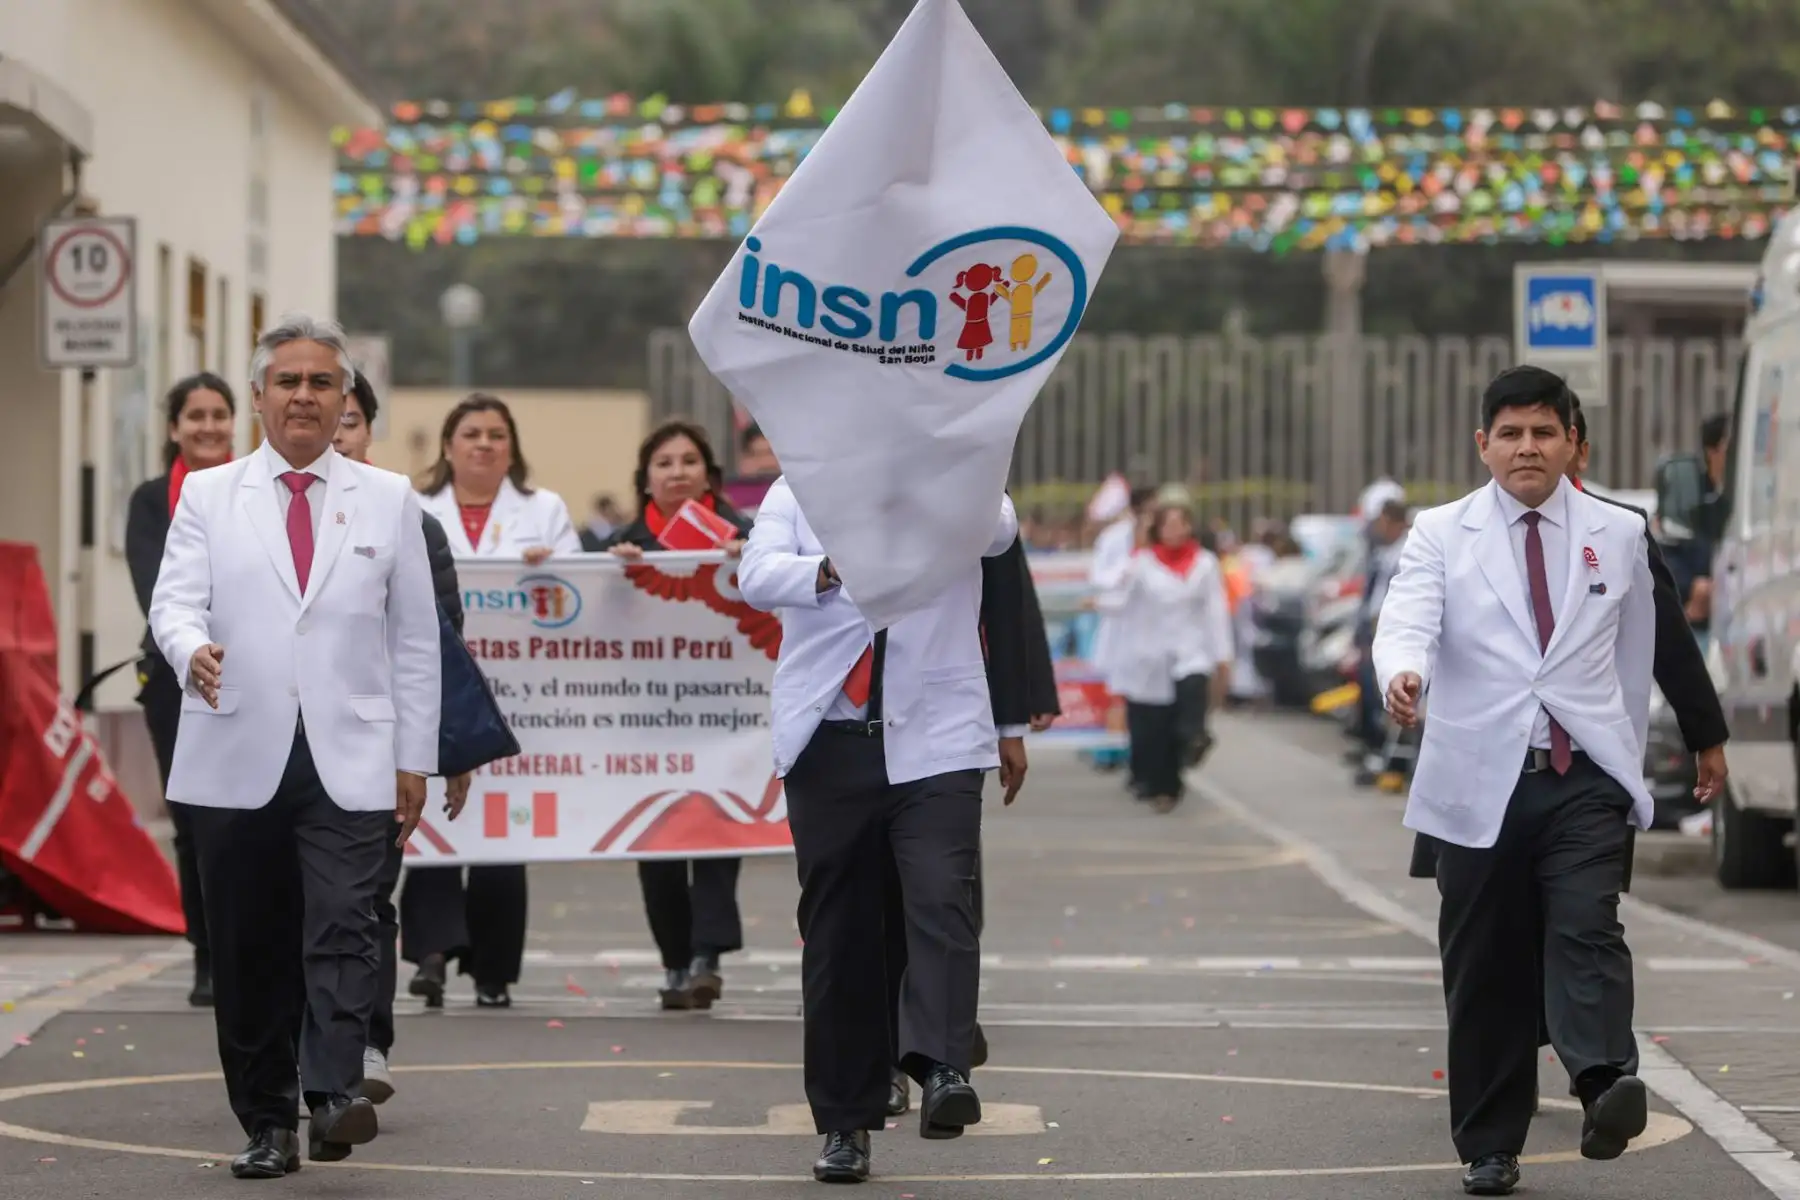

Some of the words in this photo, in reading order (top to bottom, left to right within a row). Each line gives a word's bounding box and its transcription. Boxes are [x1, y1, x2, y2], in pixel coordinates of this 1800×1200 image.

[71, 244, 108, 273] 10
[739, 236, 937, 342] insn
[738, 312, 782, 333] Instituto
[783, 326, 832, 348] Nacional
[834, 340, 849, 351] de
[851, 343, 885, 355] Salud
[888, 345, 906, 354] del
[908, 343, 935, 353] Niño
[879, 355, 902, 364] San
[904, 354, 935, 364] Borja
[463, 590, 528, 610] nsn
[466, 637, 520, 660] stas
[529, 636, 623, 660] Patrias
[632, 636, 664, 660] mi
[673, 634, 733, 660] Perú
[541, 677, 558, 697] el
[565, 677, 641, 697] mundo
[647, 680, 668, 697] tu
[674, 677, 770, 702] pasarela,
[593, 713, 613, 728] es
[620, 708, 693, 728] mucho
[699, 708, 769, 732] mejor.
[490, 753, 583, 776] GENERAL
[606, 753, 659, 775] INSN
[665, 753, 694, 774] SB
